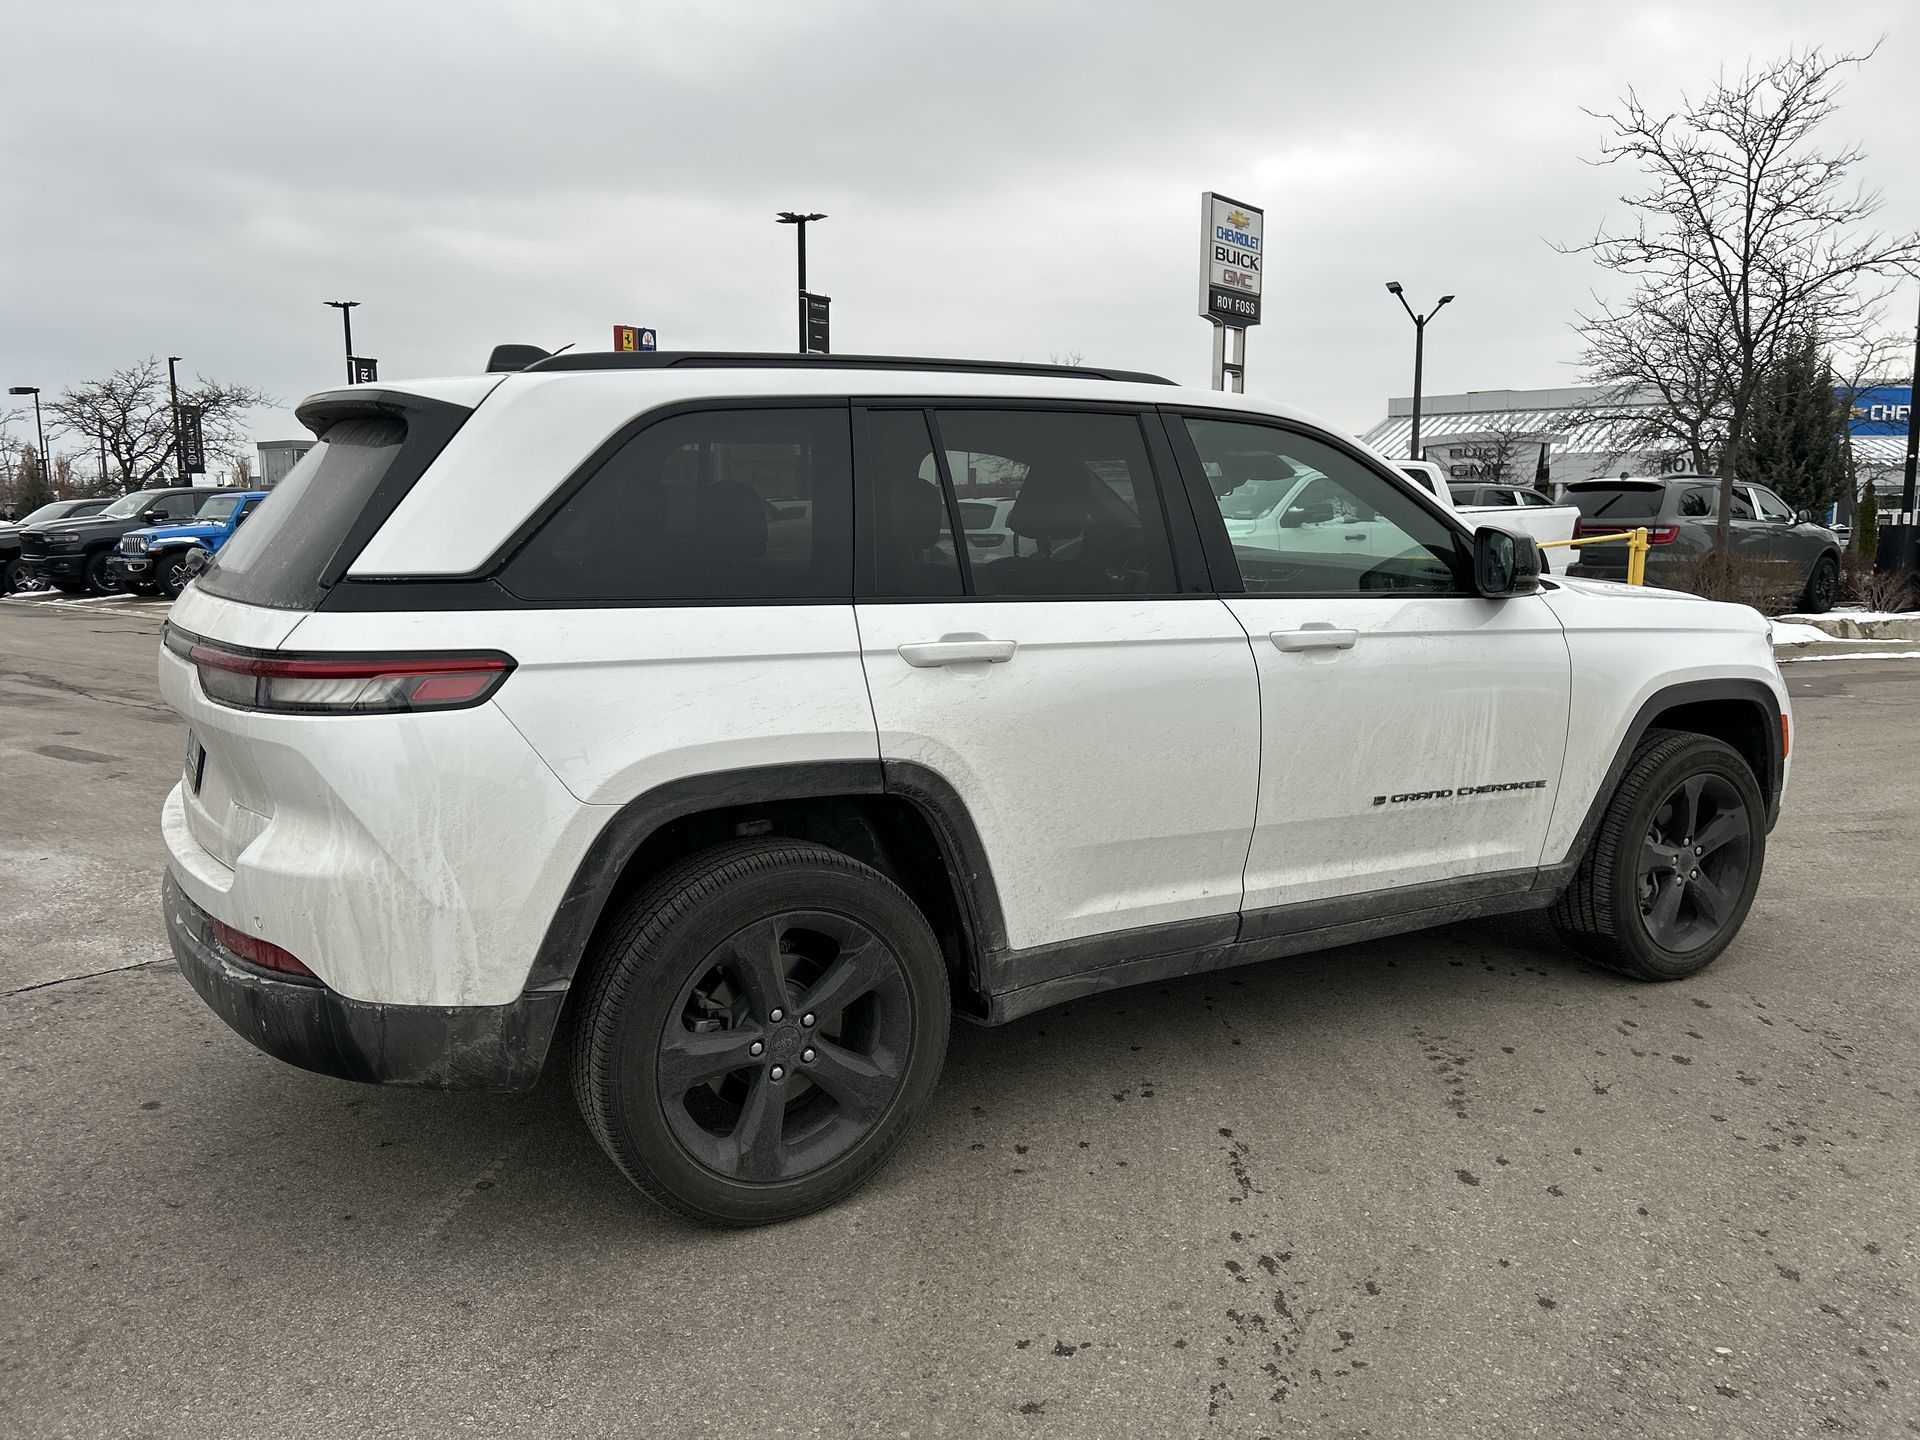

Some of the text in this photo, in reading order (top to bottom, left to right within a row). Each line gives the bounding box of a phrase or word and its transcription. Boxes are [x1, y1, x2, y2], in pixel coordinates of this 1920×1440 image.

[1216, 226, 1260, 250] CHEVROLET
[1215, 246, 1260, 271] BUICK
[1223, 269, 1253, 290] GMC
[1217, 295, 1255, 315] ROY FOSS
[1870, 404, 1911, 421] CHE
[1391, 779, 1547, 804] GRAND CHEROKEE
